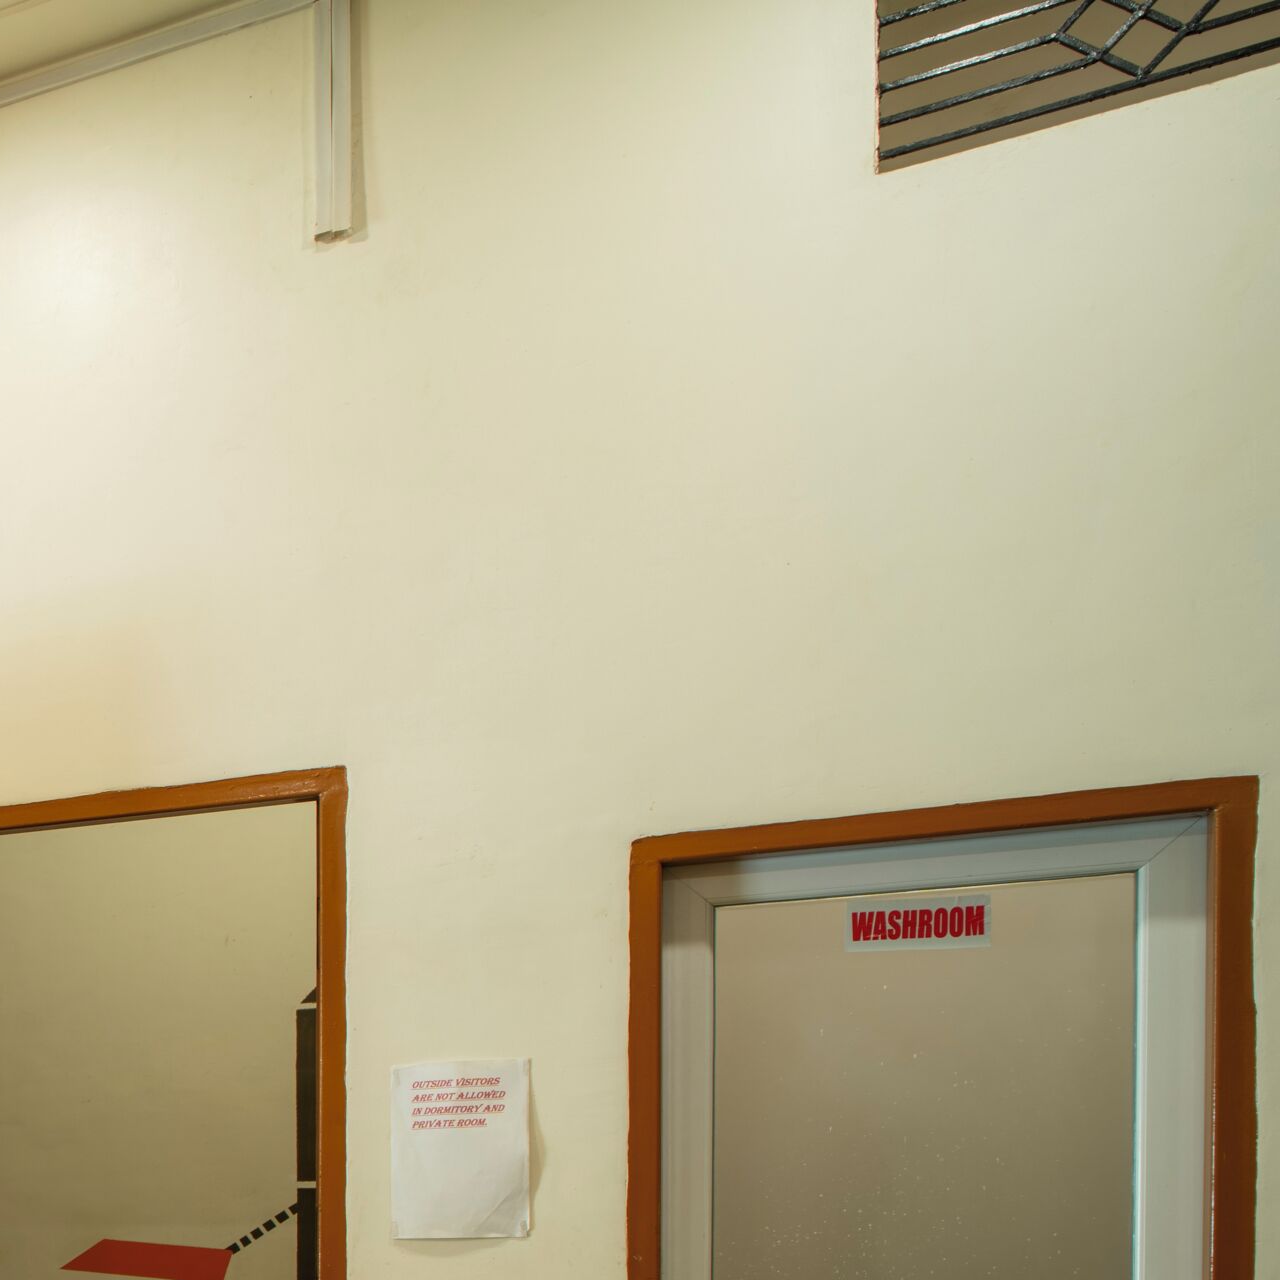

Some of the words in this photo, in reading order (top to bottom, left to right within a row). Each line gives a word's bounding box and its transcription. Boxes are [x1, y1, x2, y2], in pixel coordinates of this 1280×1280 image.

[851, 905, 985, 942] WASHROOM
[412, 1079, 452, 1089] OUTSIDE
[455, 1077, 501, 1087] VISITORS
[412, 1094, 432, 1102] ARE
[435, 1092, 456, 1101] NOT
[456, 1090, 506, 1100] ALLOWED
[412, 1107, 421, 1115] IN
[424, 1104, 483, 1115] DORMITORY
[483, 1104, 506, 1113] AND
[412, 1118, 455, 1129] PRIVATE
[456, 1118, 488, 1127] ROOM.
